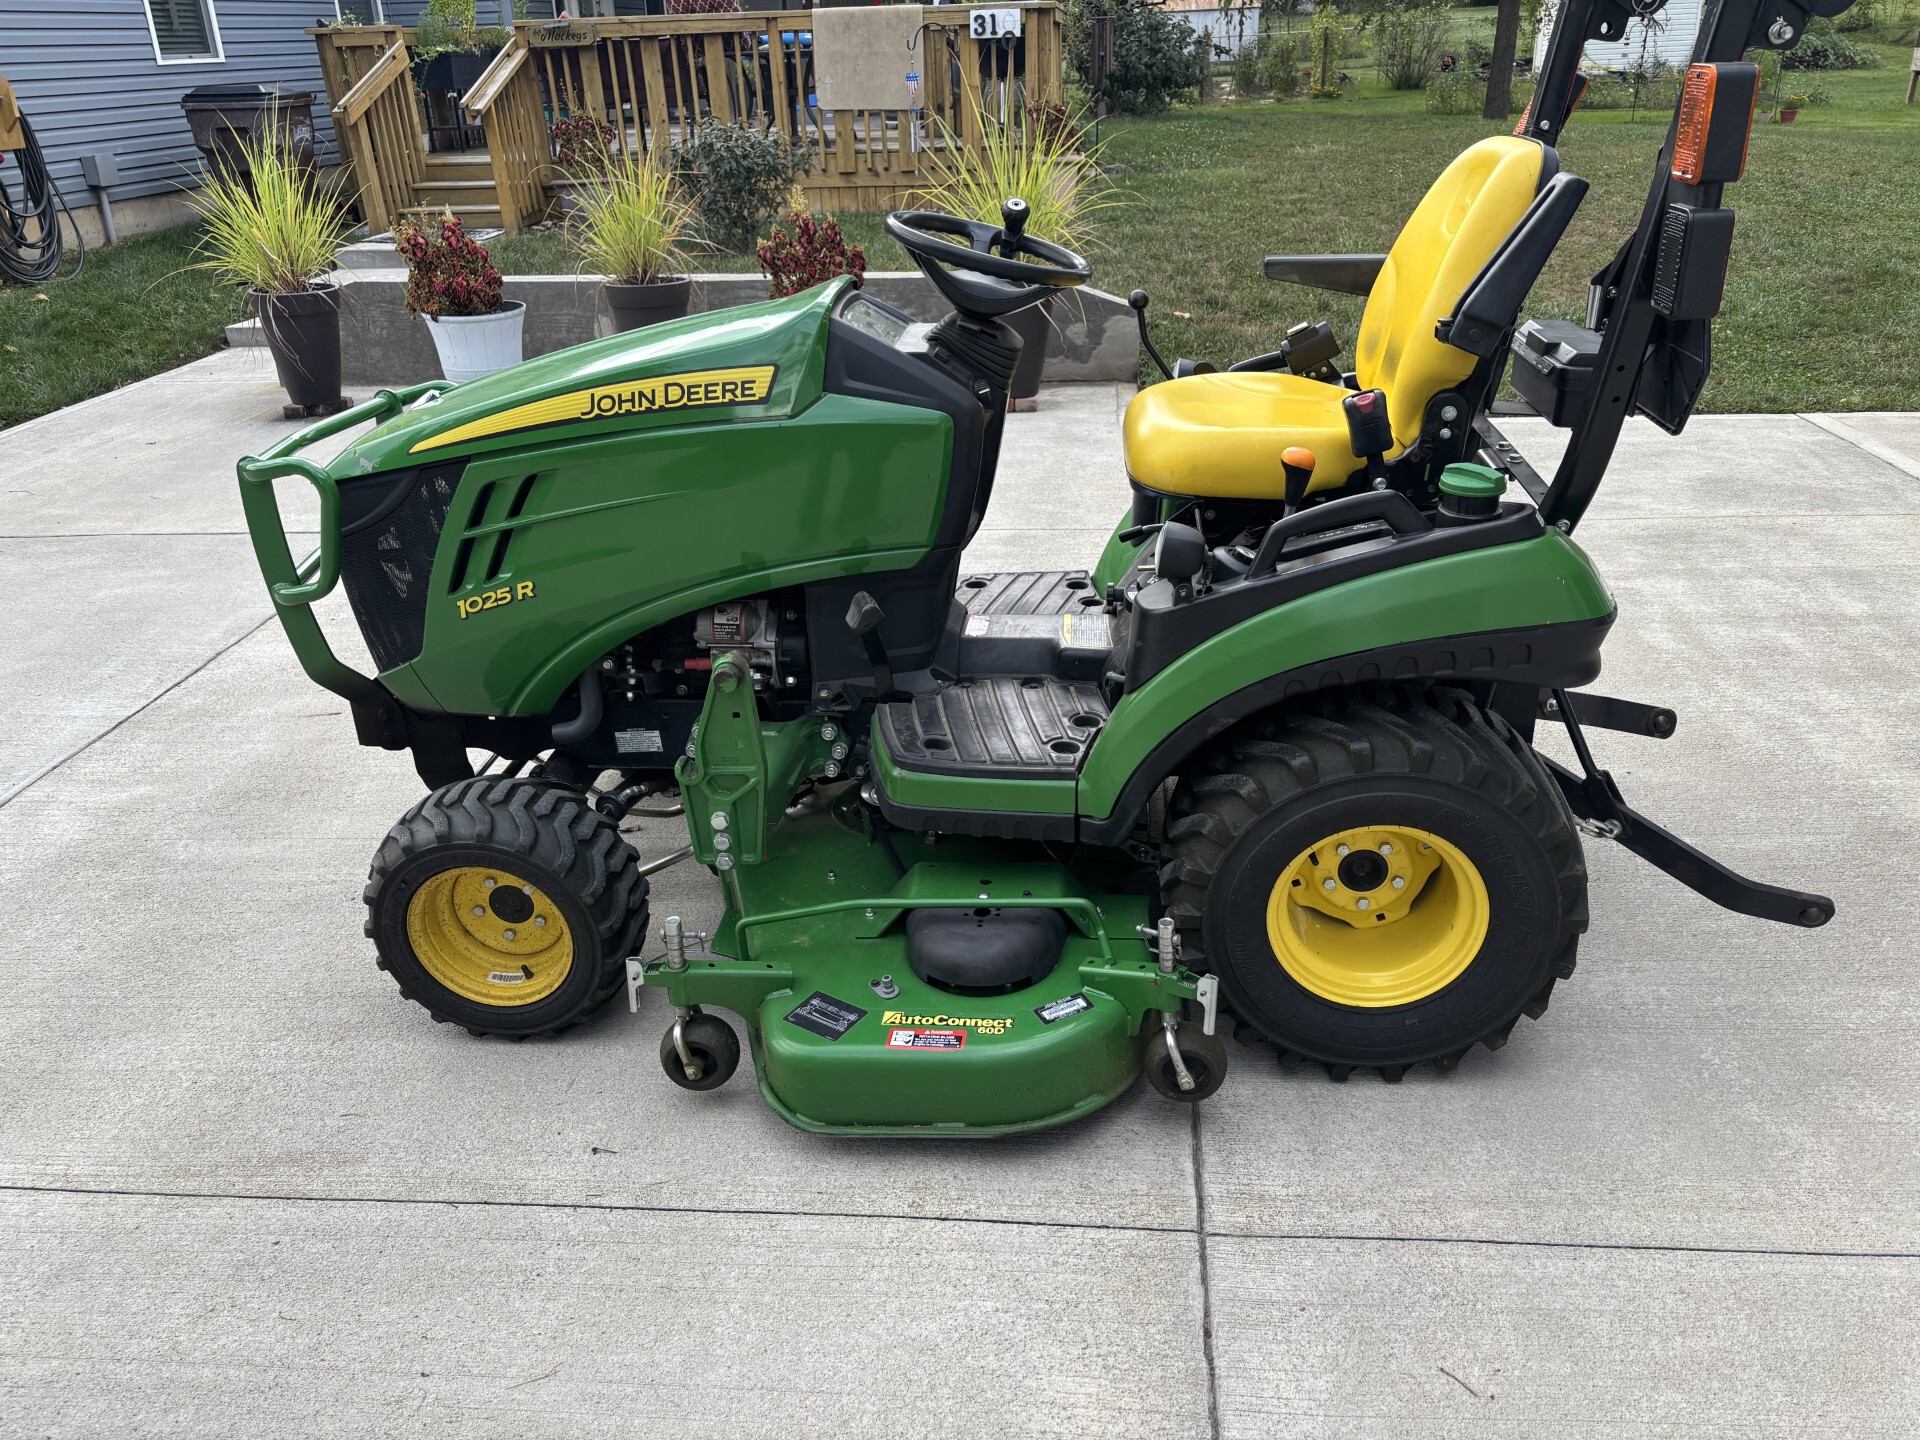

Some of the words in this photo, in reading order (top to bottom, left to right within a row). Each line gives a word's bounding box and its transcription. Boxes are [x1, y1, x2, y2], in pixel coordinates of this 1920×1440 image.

[540, 28, 588, 42] Mackeys
[581, 388, 656, 417] JOHN
[664, 379, 757, 405] DEERE
[456, 586, 513, 619] 1025
[516, 580, 536, 601] R
[881, 1011, 1014, 1028] AutoConnect
[977, 1026, 1006, 1035] 60D
